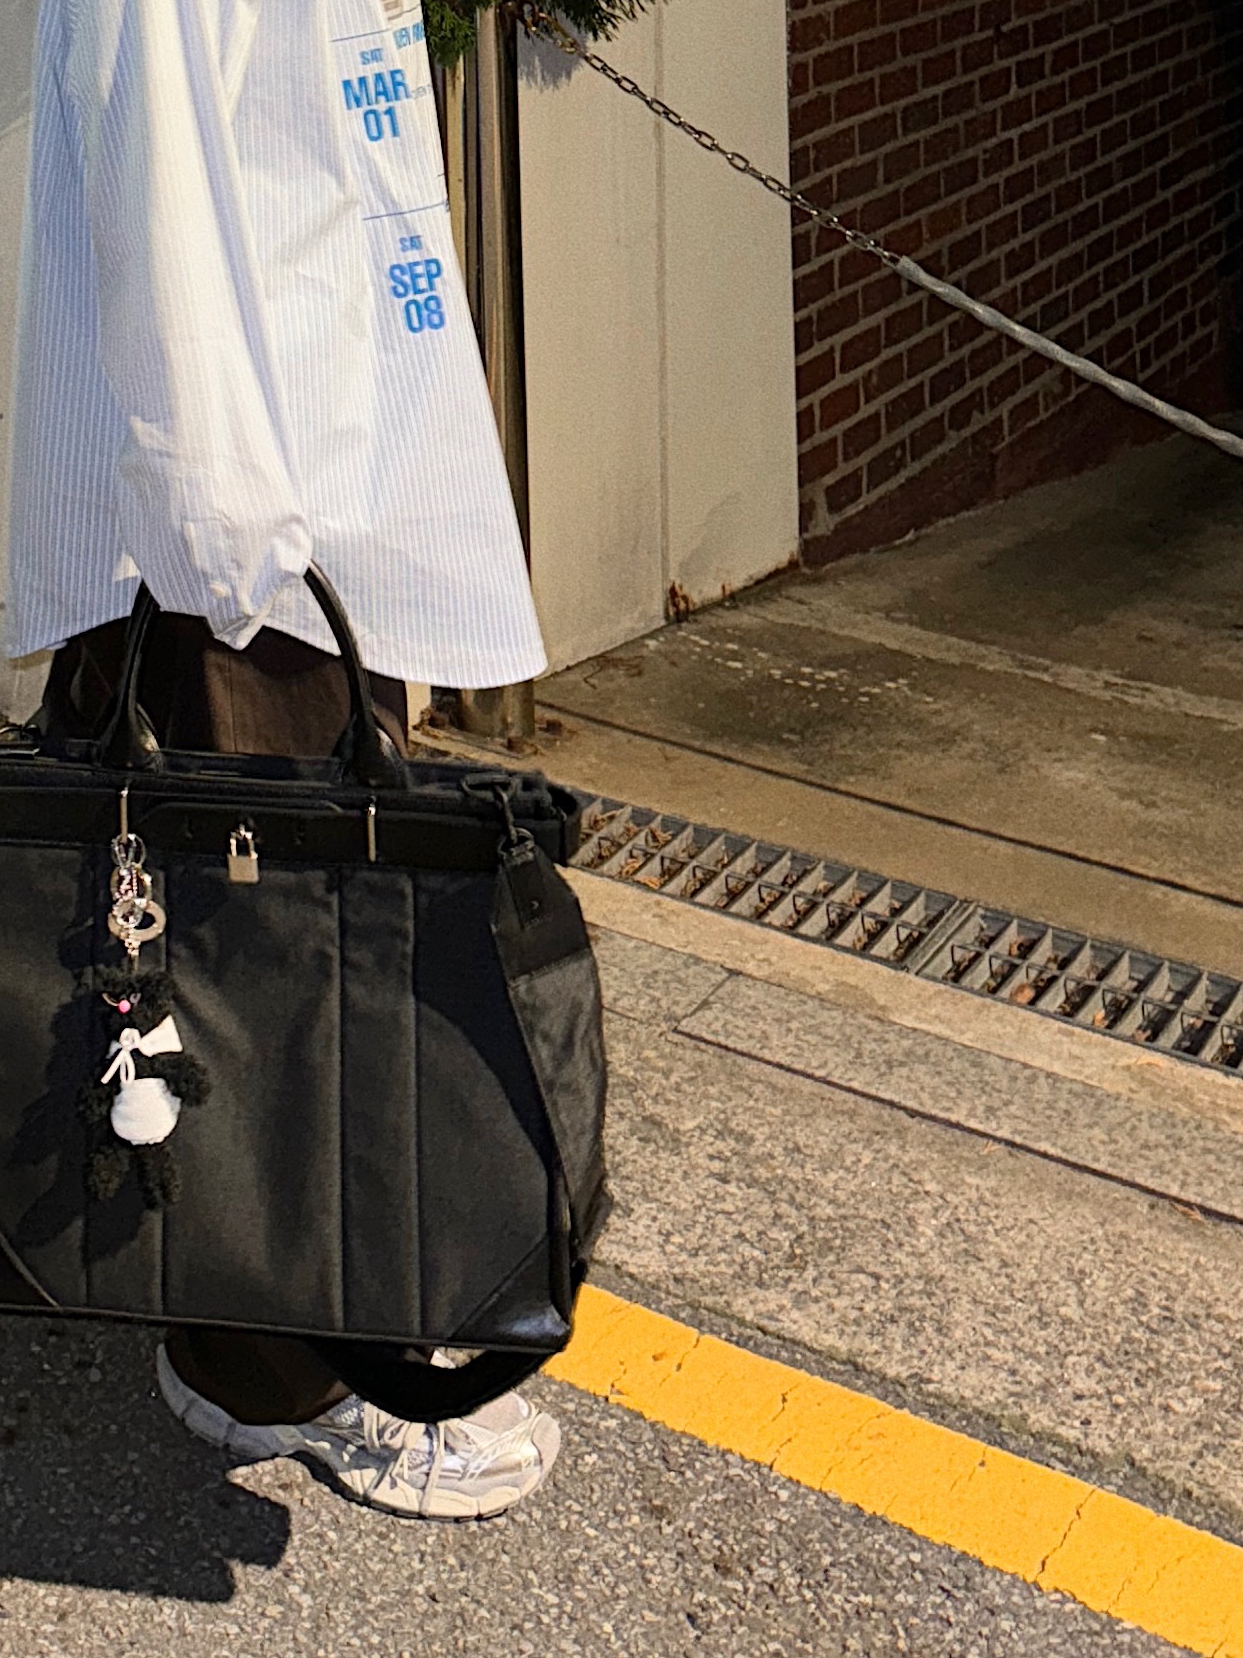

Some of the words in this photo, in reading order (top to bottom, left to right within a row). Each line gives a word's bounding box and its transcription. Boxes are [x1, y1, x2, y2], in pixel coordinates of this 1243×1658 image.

[359, 47, 383, 65] SAT
[342, 69, 412, 110] MAR
[363, 107, 400, 142] 01
[399, 235, 422, 253] SAT
[389, 258, 442, 299] SEP
[404, 295, 445, 334] 08
